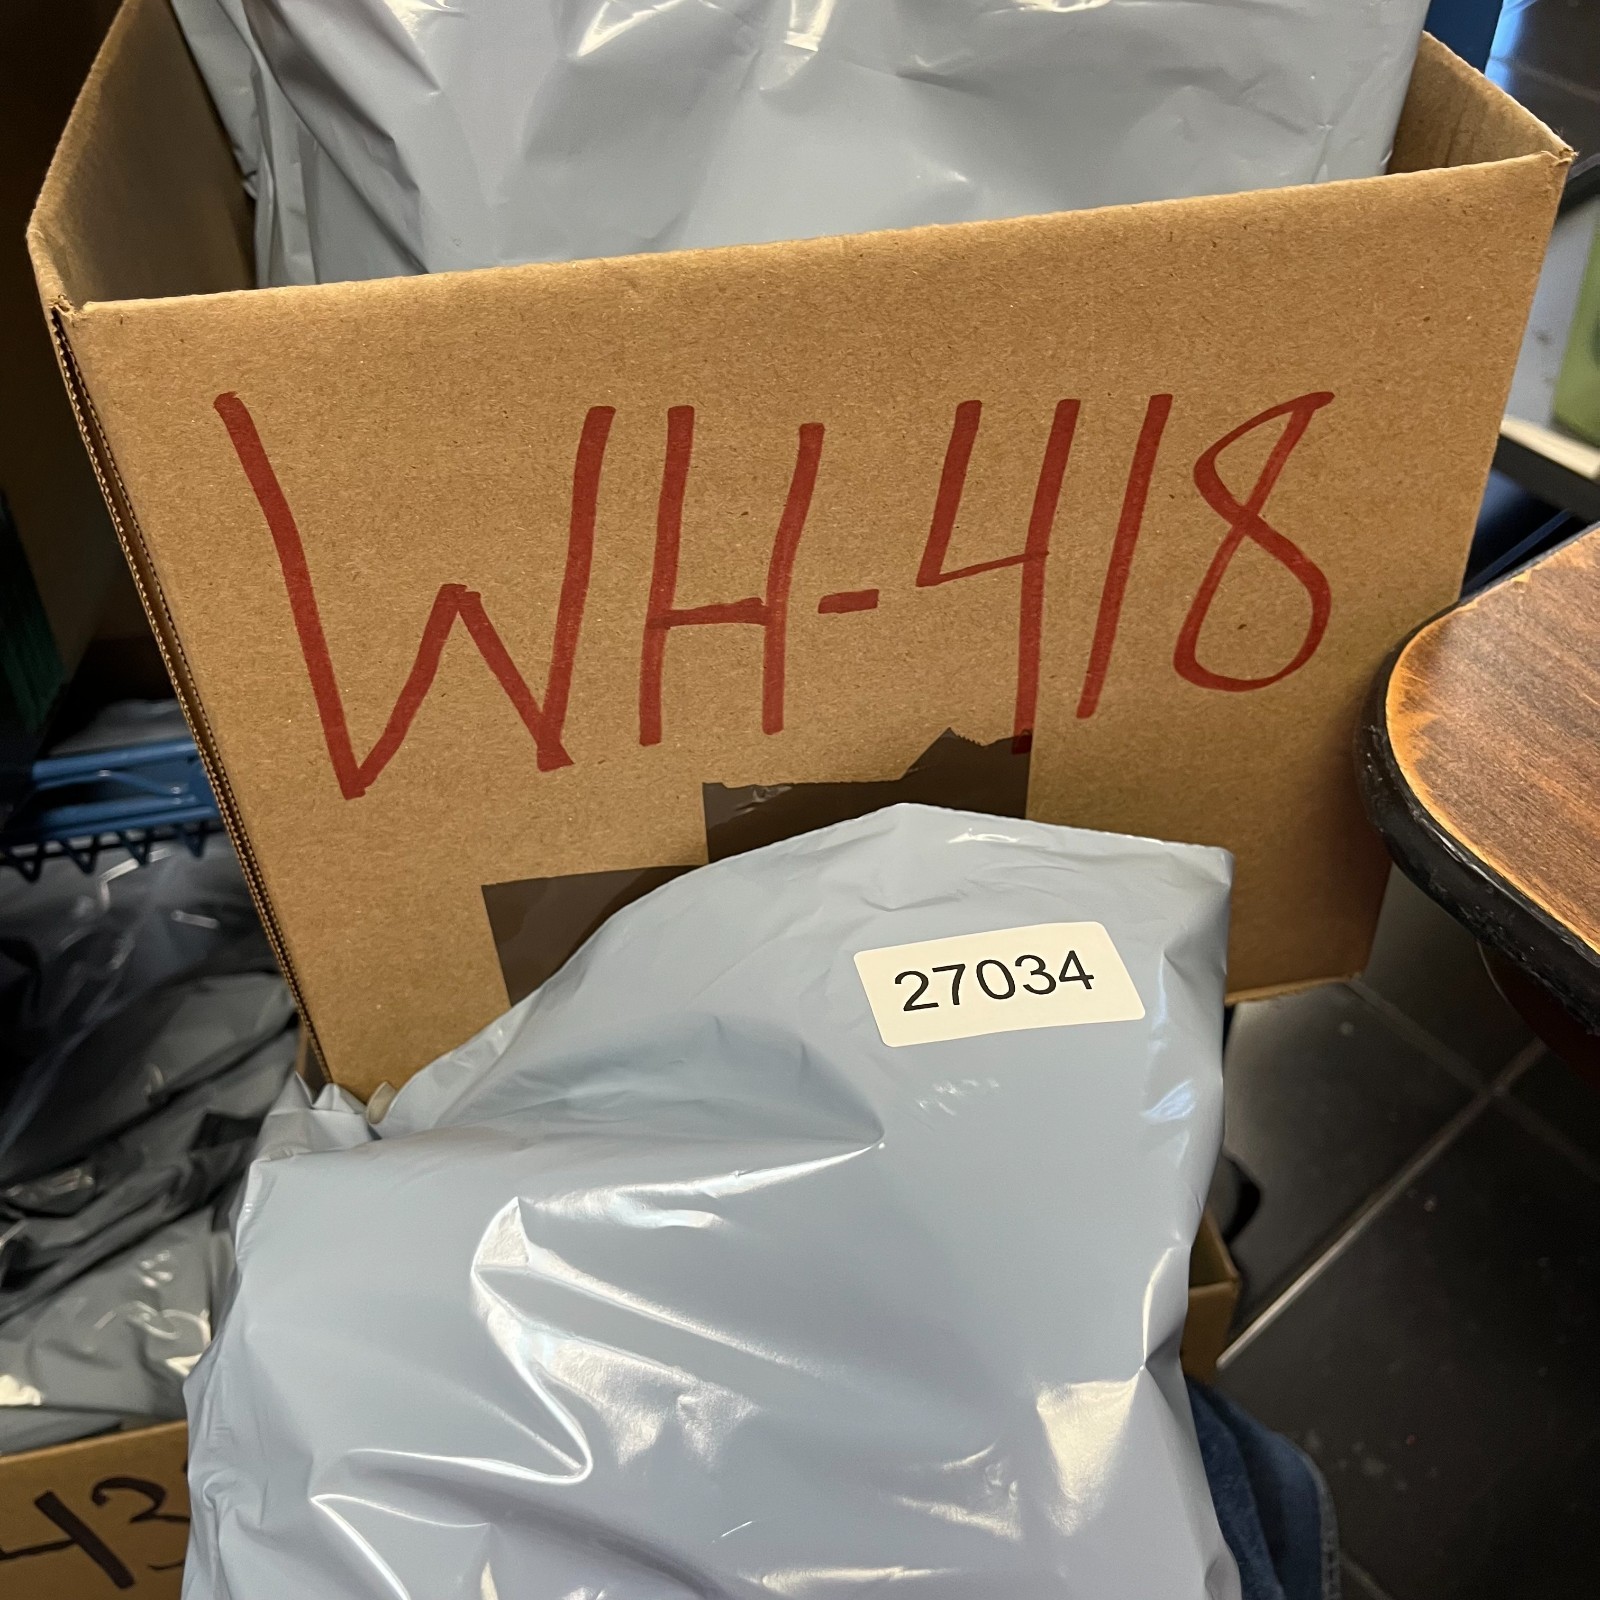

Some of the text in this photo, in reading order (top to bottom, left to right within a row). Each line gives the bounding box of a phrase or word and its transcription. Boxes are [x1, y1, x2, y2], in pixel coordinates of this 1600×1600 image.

[214, 391, 1334, 800] WH-418
[893, 949, 1096, 1013] 27034
[0, 1459, 191, 1590] 43
